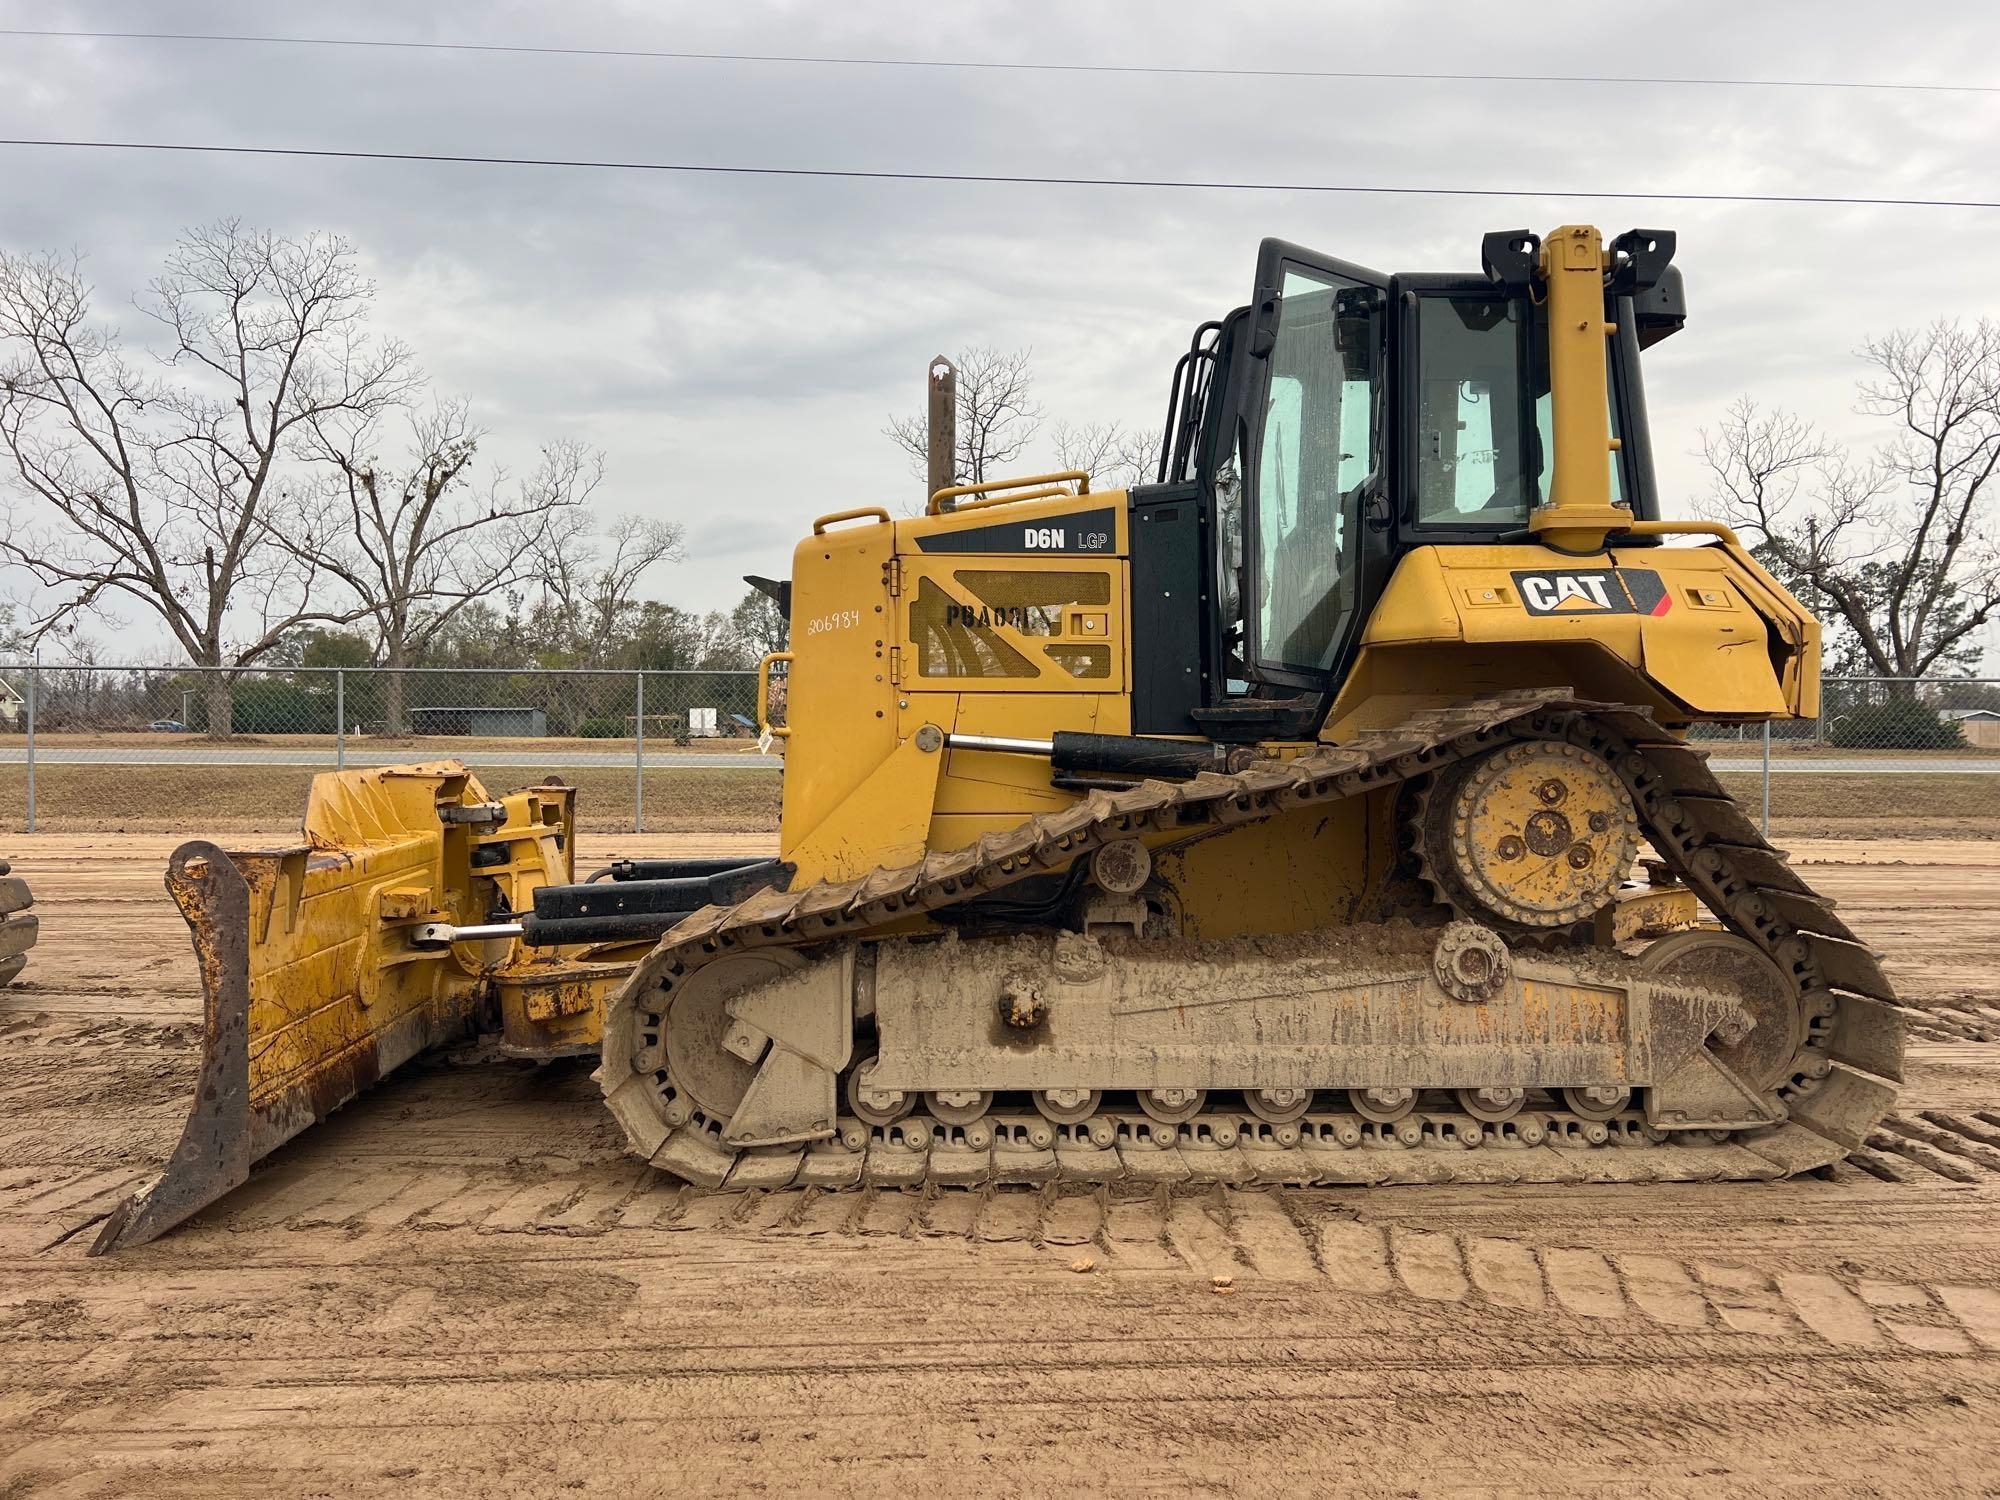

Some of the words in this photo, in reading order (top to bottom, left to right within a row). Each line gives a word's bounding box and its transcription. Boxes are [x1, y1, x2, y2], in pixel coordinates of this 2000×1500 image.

[1024, 528, 1065, 549] D6N
[1077, 532, 1108, 549] LGP
[1522, 575, 1613, 611] CAT
[807, 610, 859, 636] 206984
